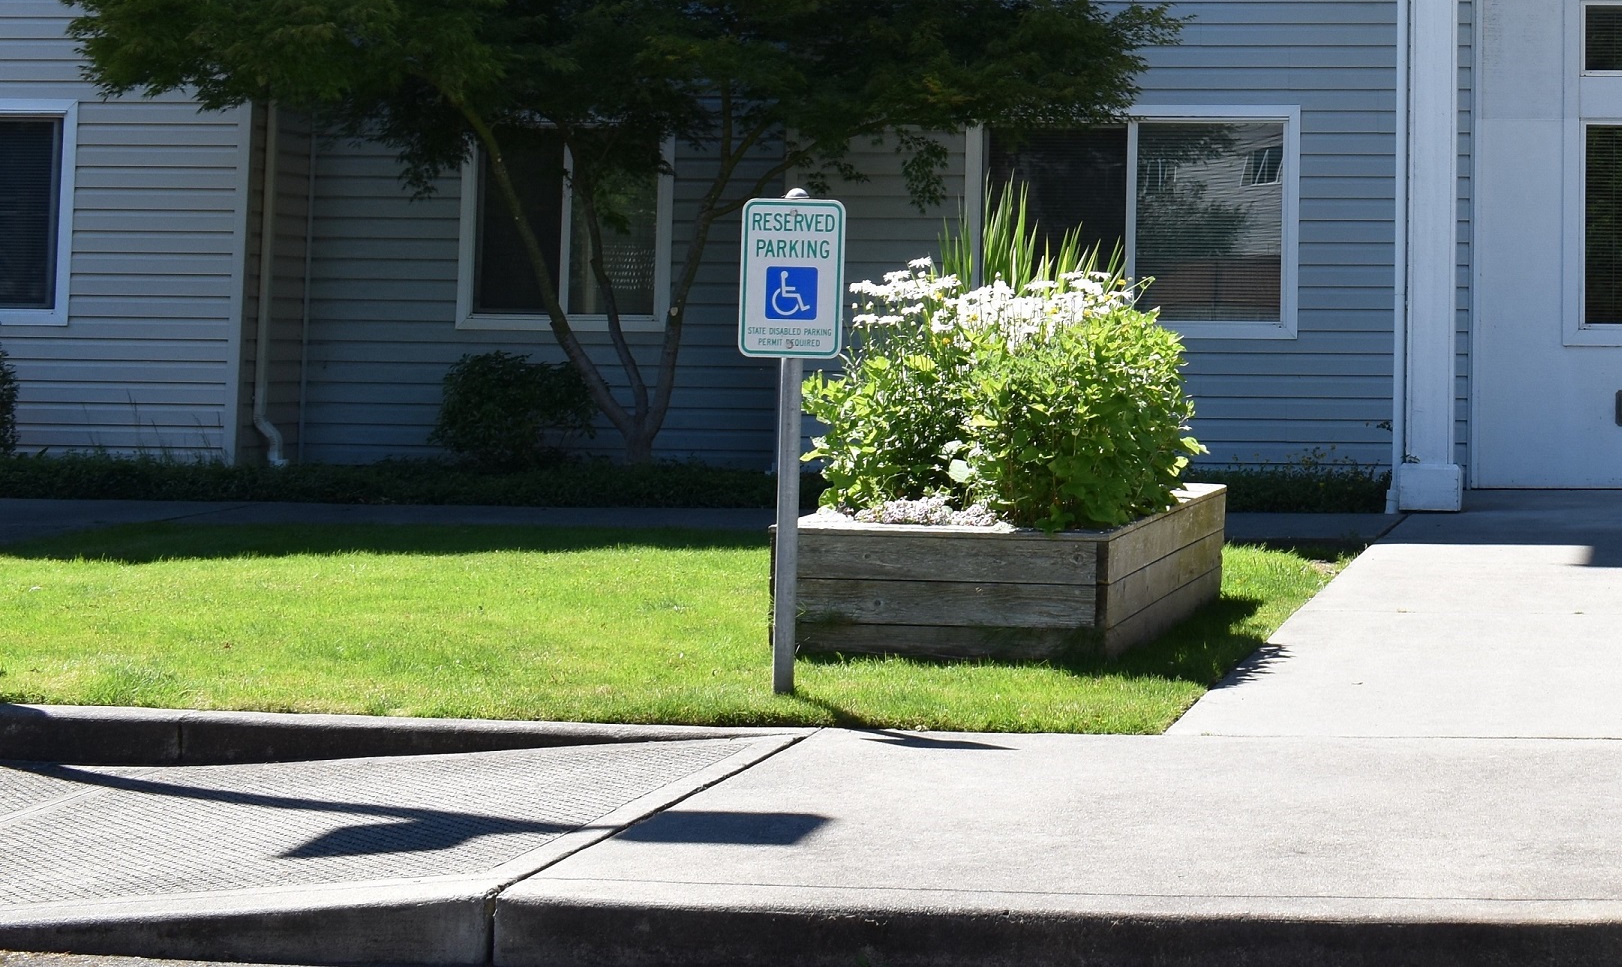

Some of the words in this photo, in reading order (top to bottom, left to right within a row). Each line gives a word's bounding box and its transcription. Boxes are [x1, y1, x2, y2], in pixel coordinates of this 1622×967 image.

[752, 212, 836, 233] RESERVED
[756, 239, 830, 259] PARKING
[747, 326, 767, 335] STATE
[769, 327, 801, 336] DISABLED
[803, 328, 832, 337] PARKING
[758, 337, 783, 347] PERMIT
